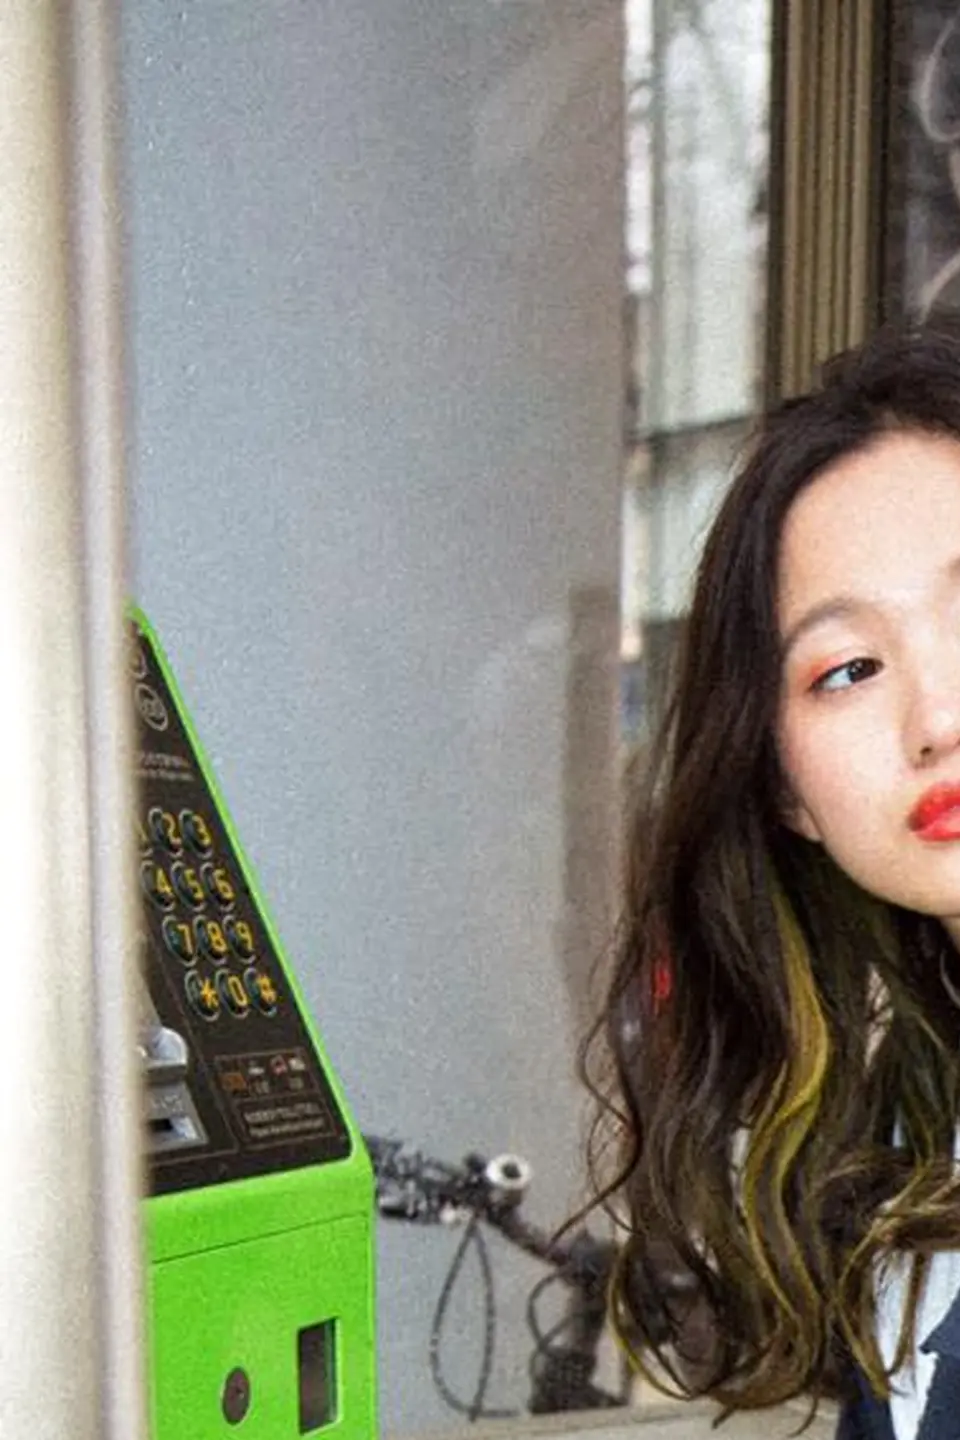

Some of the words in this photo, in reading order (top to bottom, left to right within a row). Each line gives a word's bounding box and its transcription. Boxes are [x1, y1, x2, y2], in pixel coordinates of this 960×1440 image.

[162, 812, 181, 844] 2
[191, 814, 211, 845] 3
[156, 867, 174, 896] 4
[184, 868, 204, 898] 5
[213, 868, 234, 899] 6
[177, 923, 194, 955] 7
[206, 921, 227, 953] 8
[235, 921, 254, 951] 9
[227, 975, 248, 1006] 0
